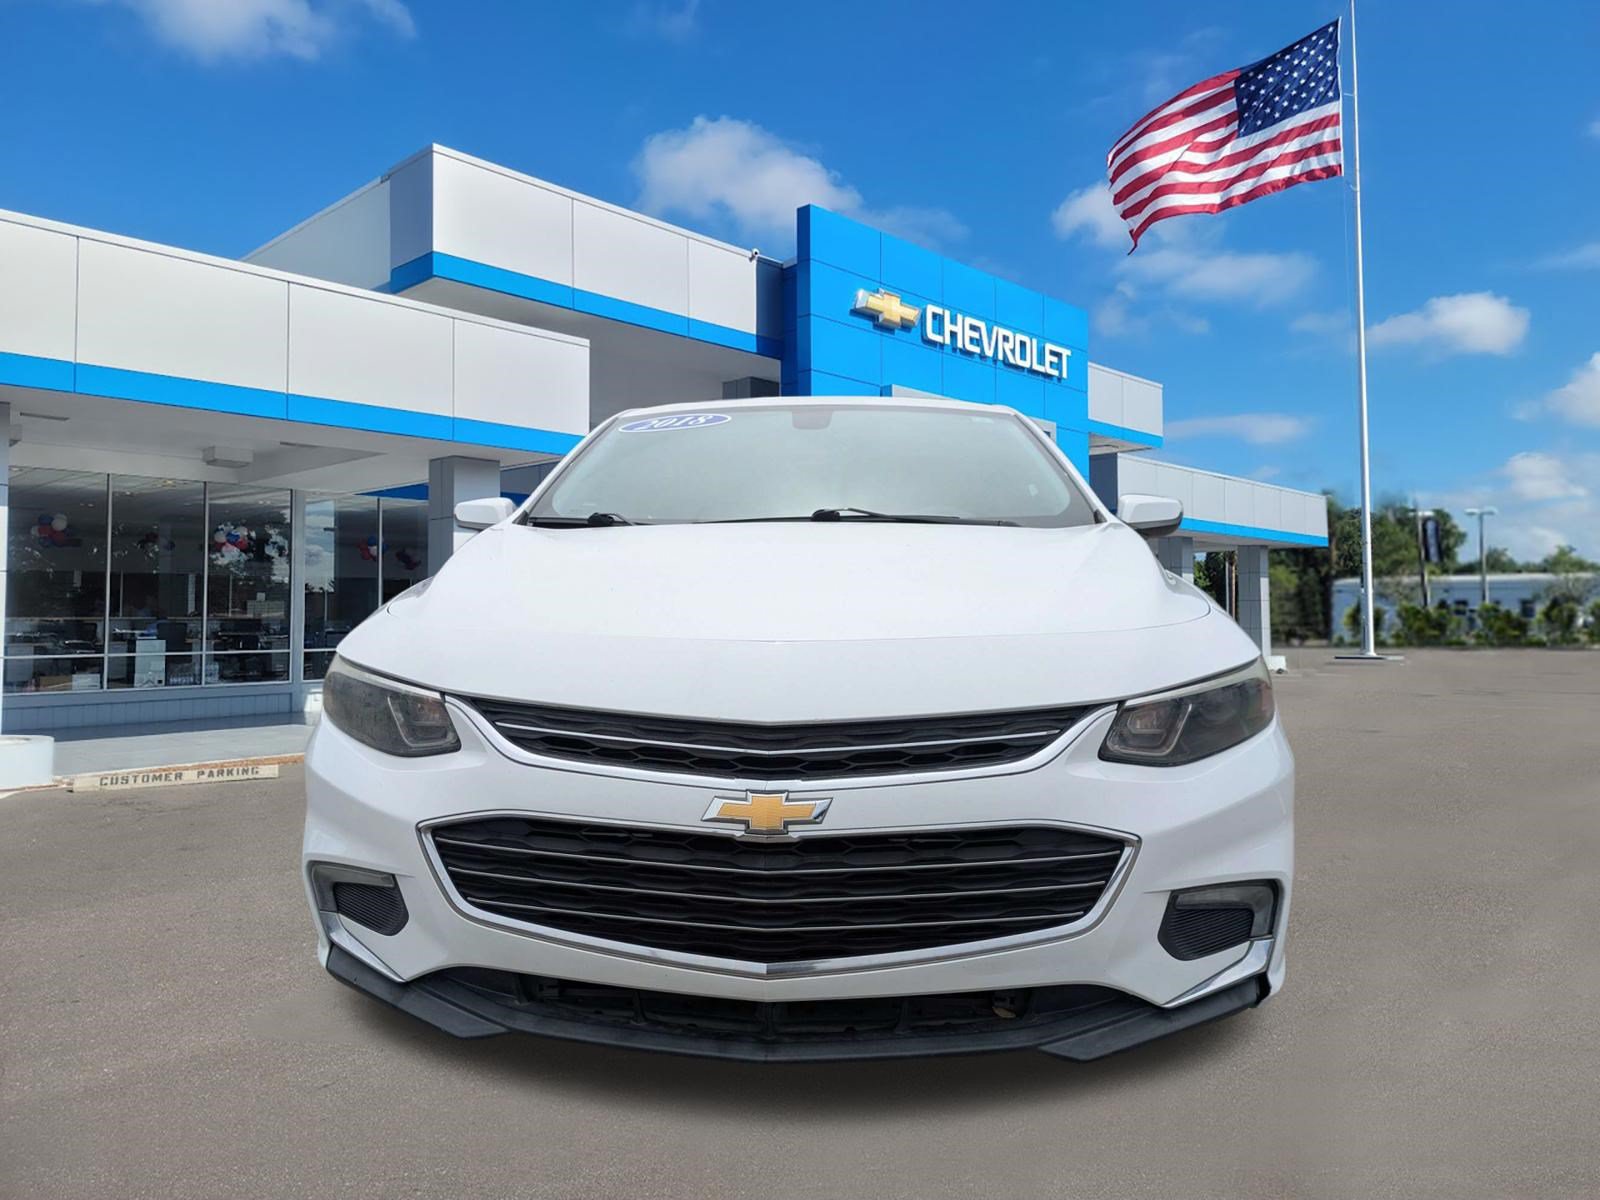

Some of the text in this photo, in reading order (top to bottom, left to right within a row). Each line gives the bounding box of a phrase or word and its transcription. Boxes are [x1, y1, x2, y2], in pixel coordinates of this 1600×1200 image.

[925, 303, 1072, 379] CHEVROLET
[632, 414, 714, 430] 2018
[99, 766, 260, 787] CUSTOMER PARKING
